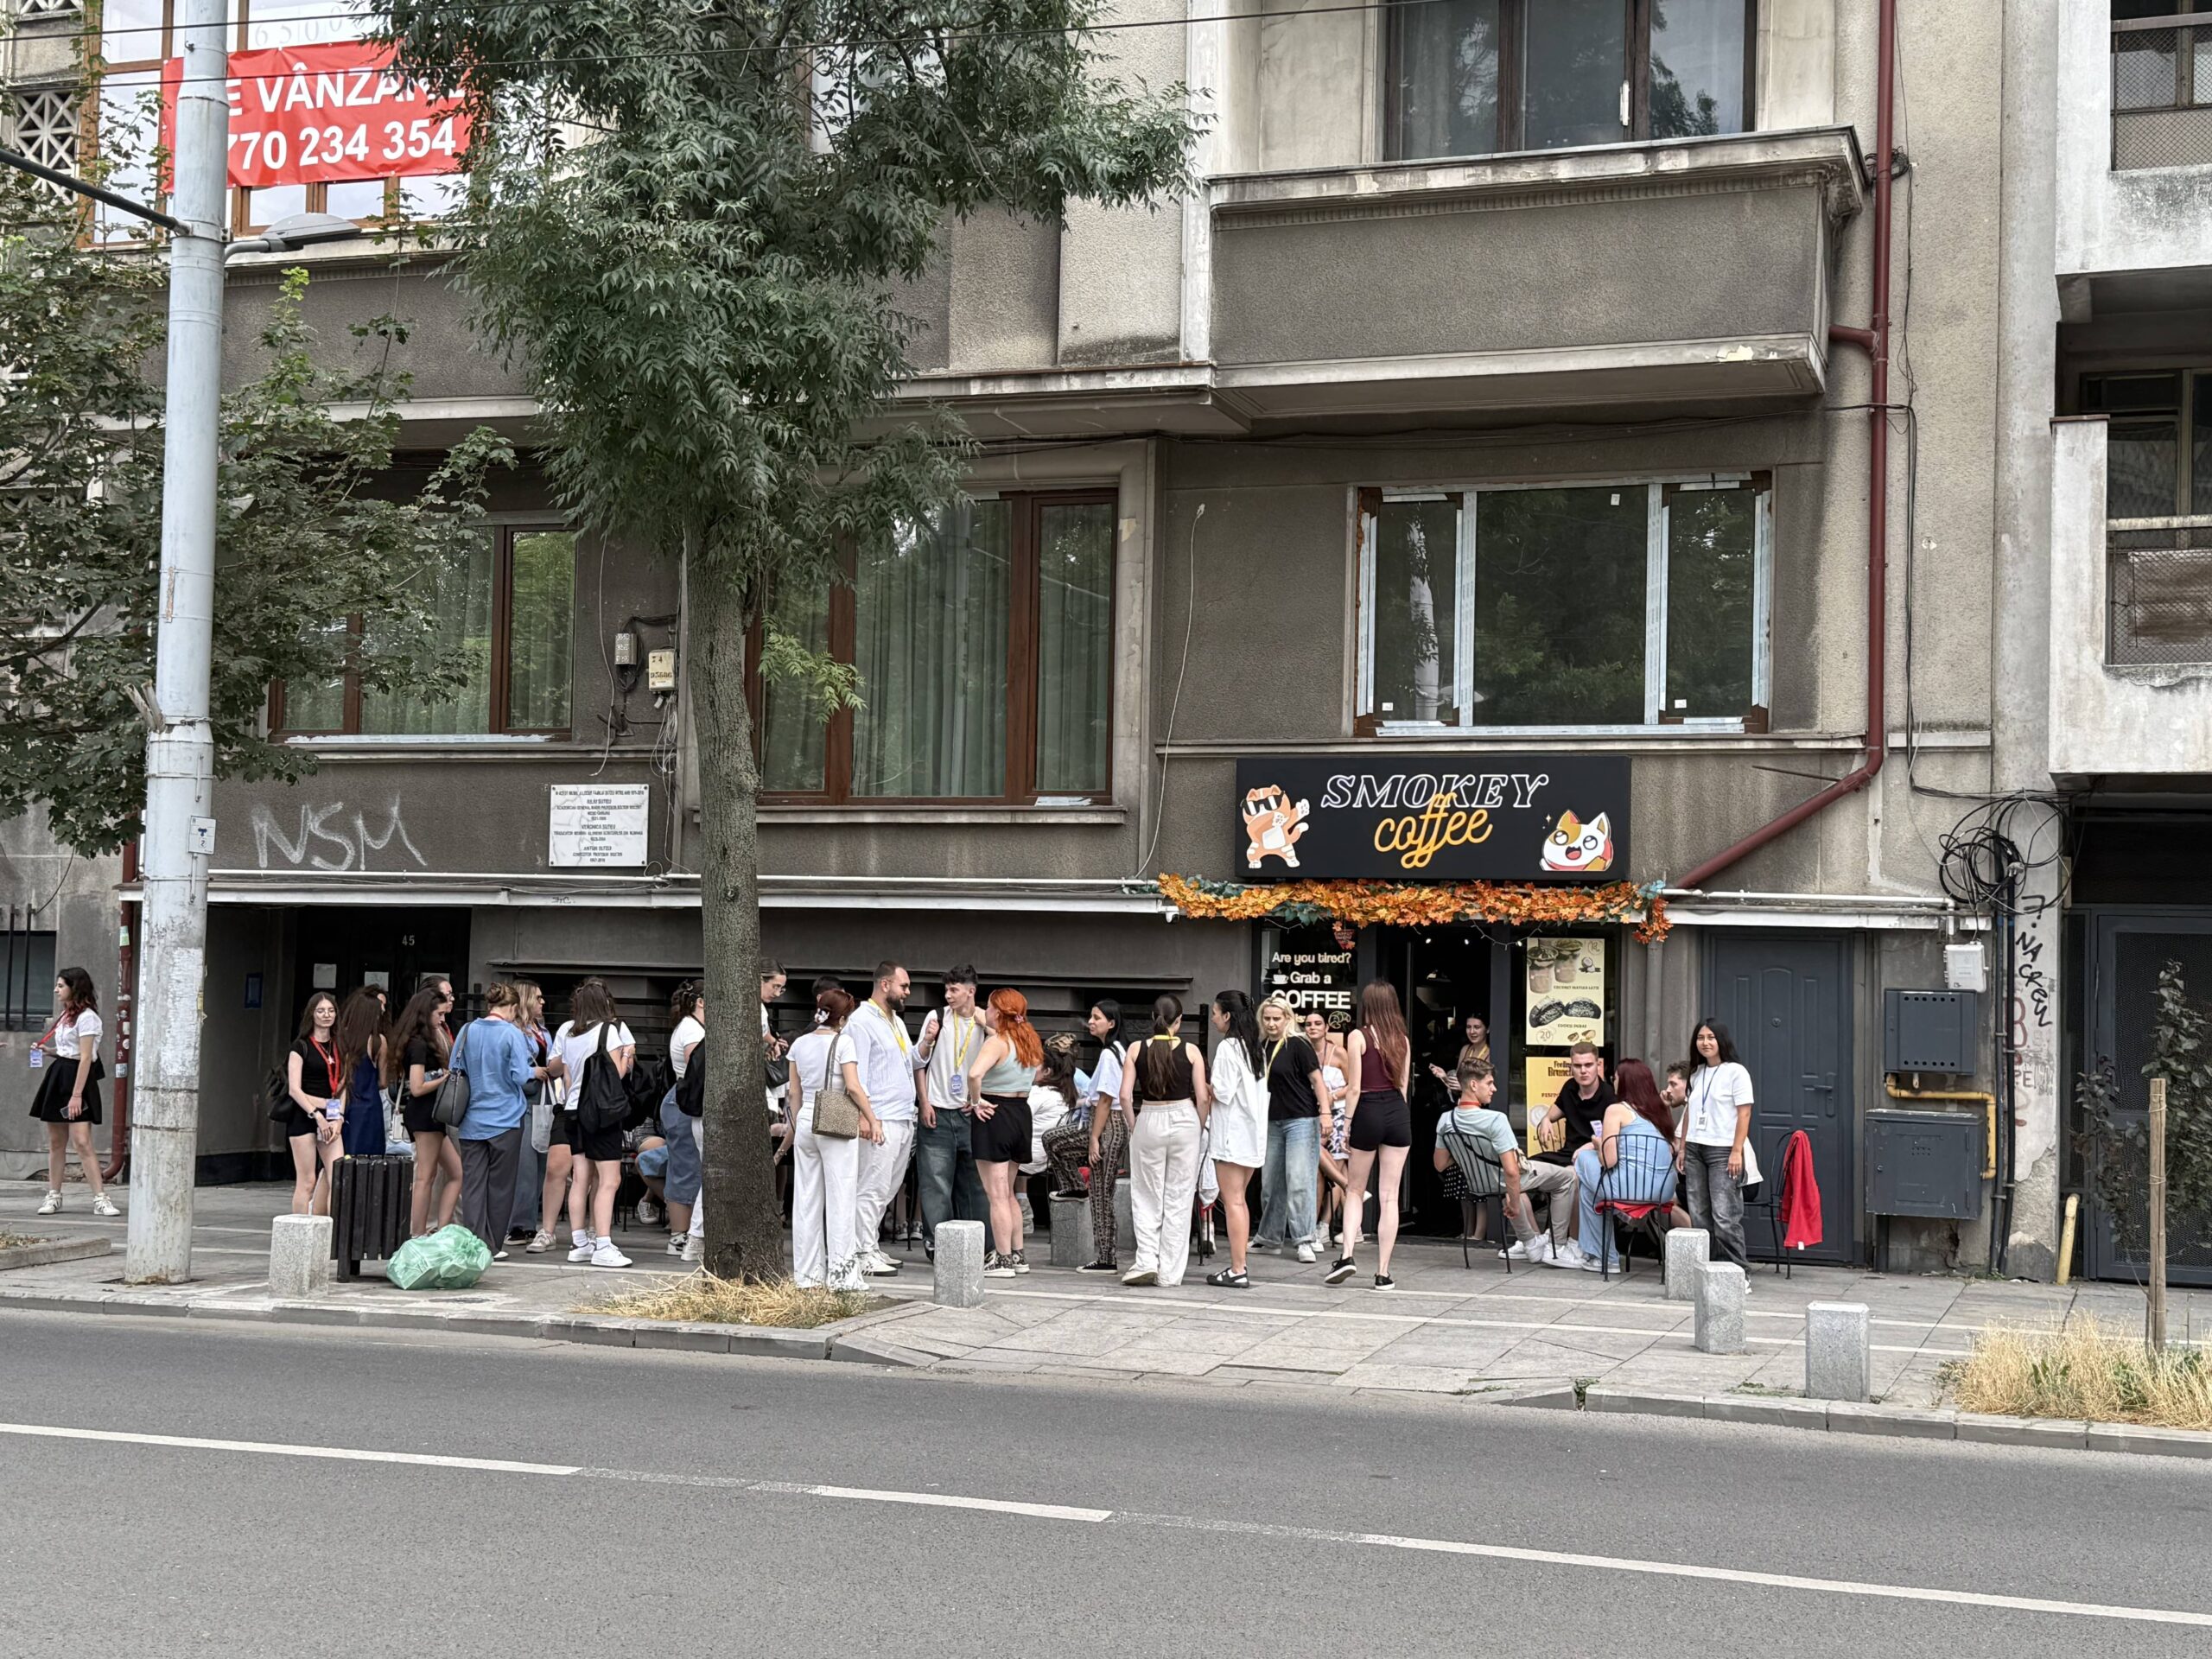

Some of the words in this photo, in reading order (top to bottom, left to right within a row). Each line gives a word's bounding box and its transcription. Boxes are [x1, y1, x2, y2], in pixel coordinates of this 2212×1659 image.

[226, 78, 243, 117] E
[299, 125, 369, 167] 234
[382, 117, 457, 161] 354
[1320, 773, 1549, 809] SMOKEY
[1374, 791, 1493, 869] coffee
[402, 934, 416, 946] 45
[1272, 952, 1292, 963] Are
[1294, 954, 1315, 966] you
[1318, 952, 1351, 963] tired?
[1290, 971, 1320, 984] Grab
[1323, 974, 1332, 984] a
